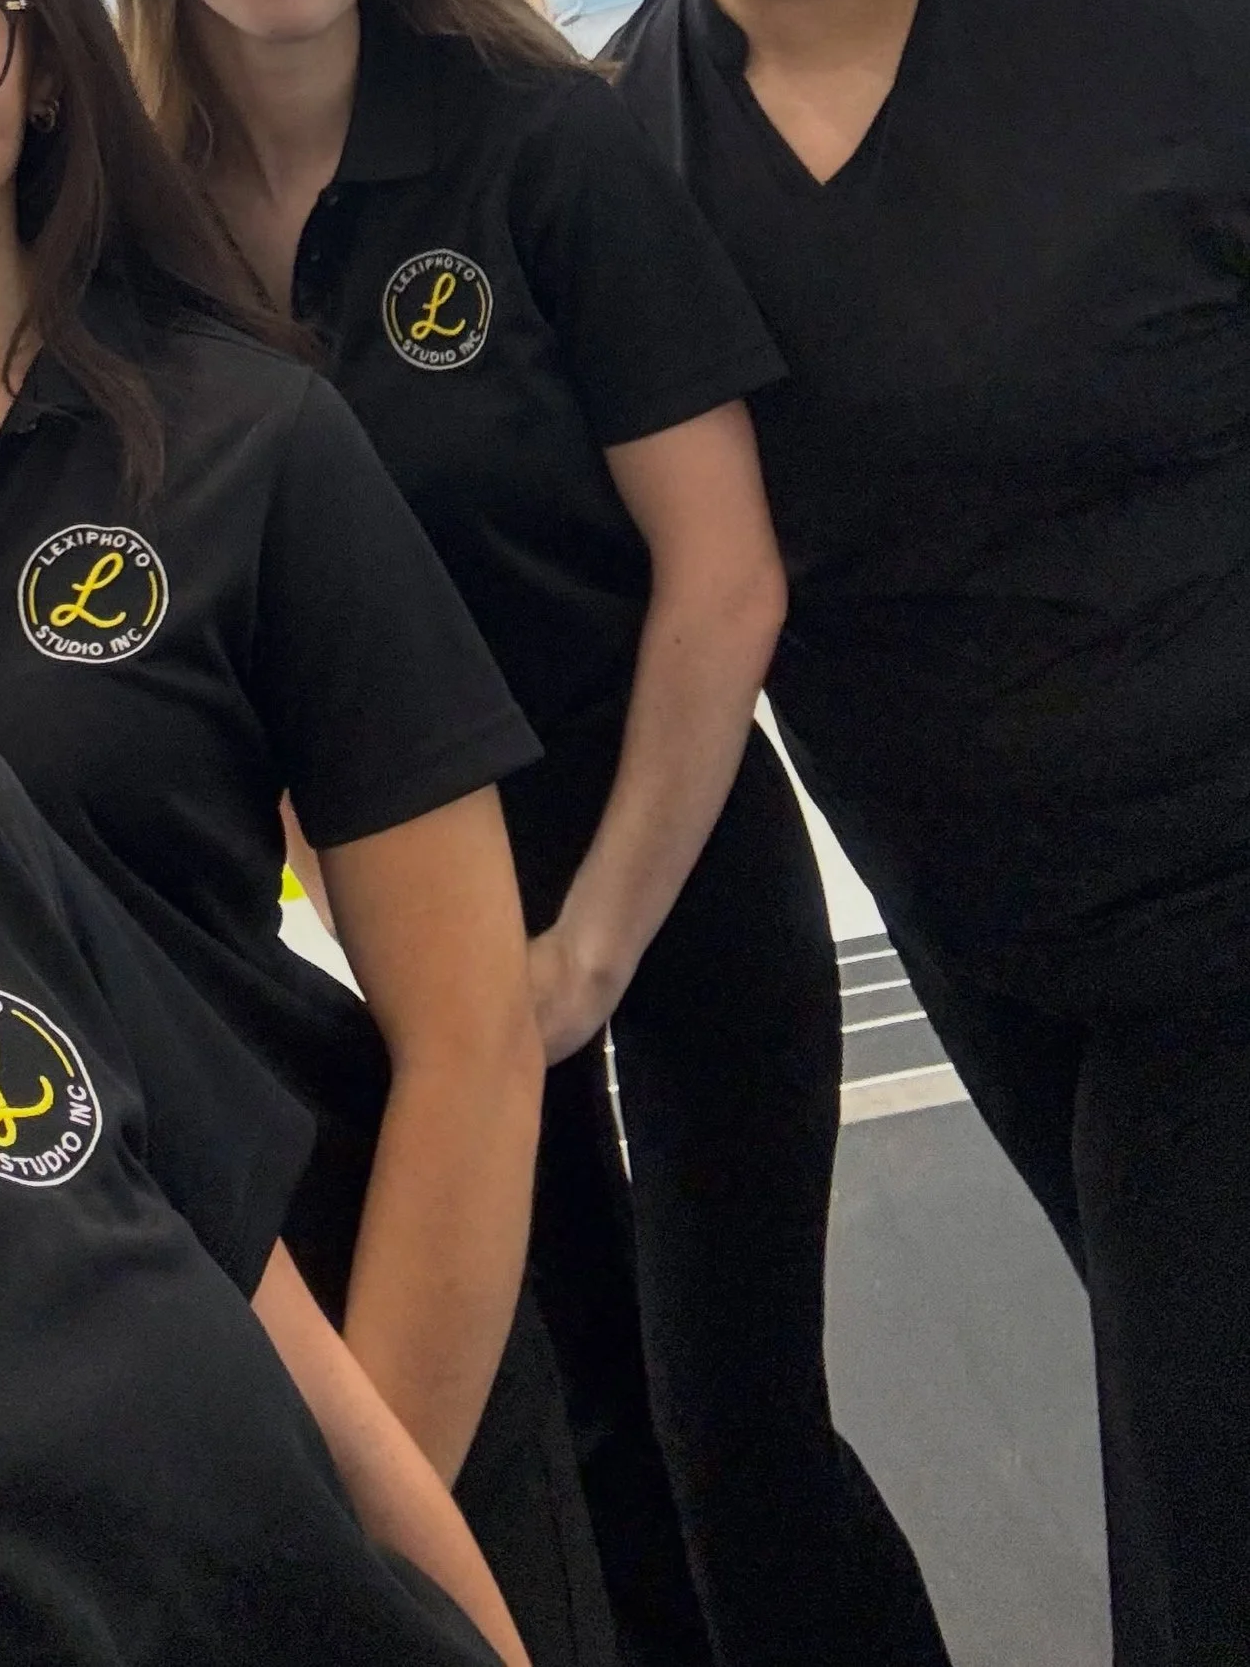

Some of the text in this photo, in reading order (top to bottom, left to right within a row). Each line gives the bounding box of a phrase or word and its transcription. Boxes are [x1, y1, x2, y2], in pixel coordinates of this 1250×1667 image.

[393, 256, 476, 292] LEXIPHOTO
[402, 339, 457, 363] STUDIO
[39, 531, 151, 567] LEXIPHOTO
[36, 625, 104, 656] STUDIO
[110, 628, 143, 653] INC
[67, 1085, 102, 1127] INC
